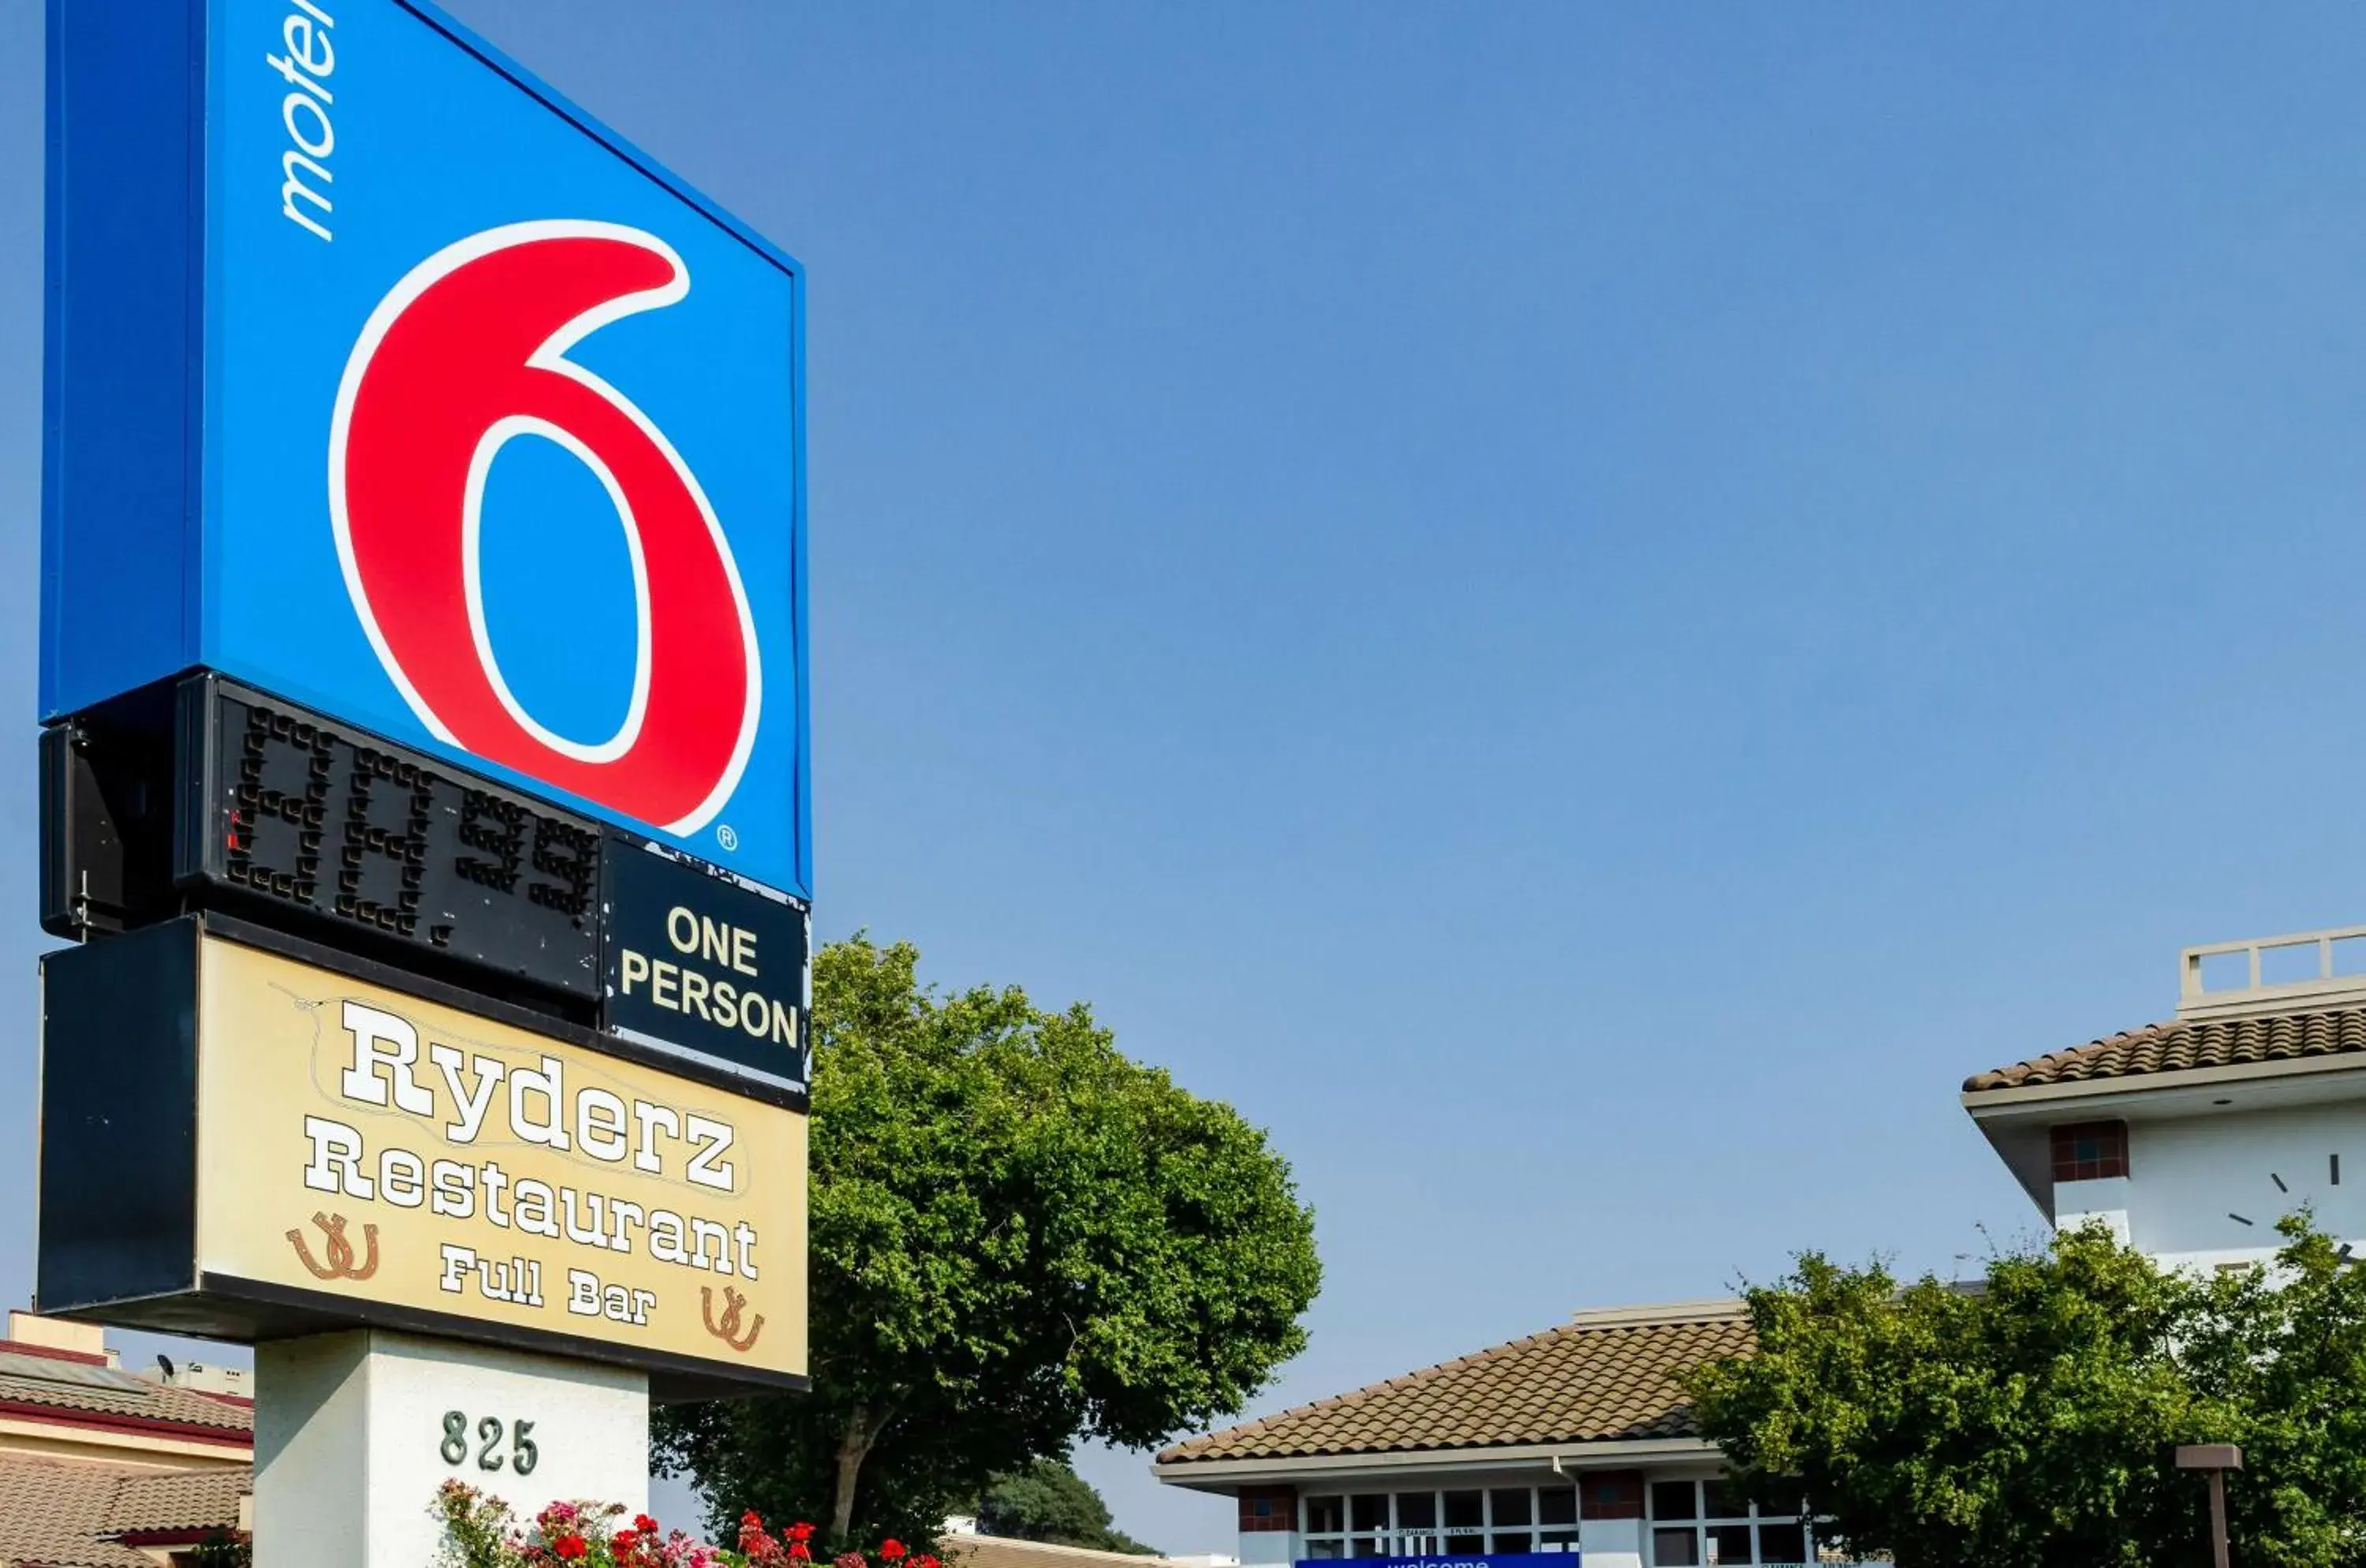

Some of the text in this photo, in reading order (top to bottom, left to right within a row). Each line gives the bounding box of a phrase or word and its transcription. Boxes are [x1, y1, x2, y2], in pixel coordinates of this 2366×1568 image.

[328, 219, 762, 838] 6
[668, 906, 758, 977] ONE
[621, 949, 797, 1048] PERSON
[341, 999, 734, 1193] Ryderz
[304, 1115, 758, 1281] Restaurant
[439, 1243, 656, 1327] Full Bar
[440, 1409, 539, 1477] 825
